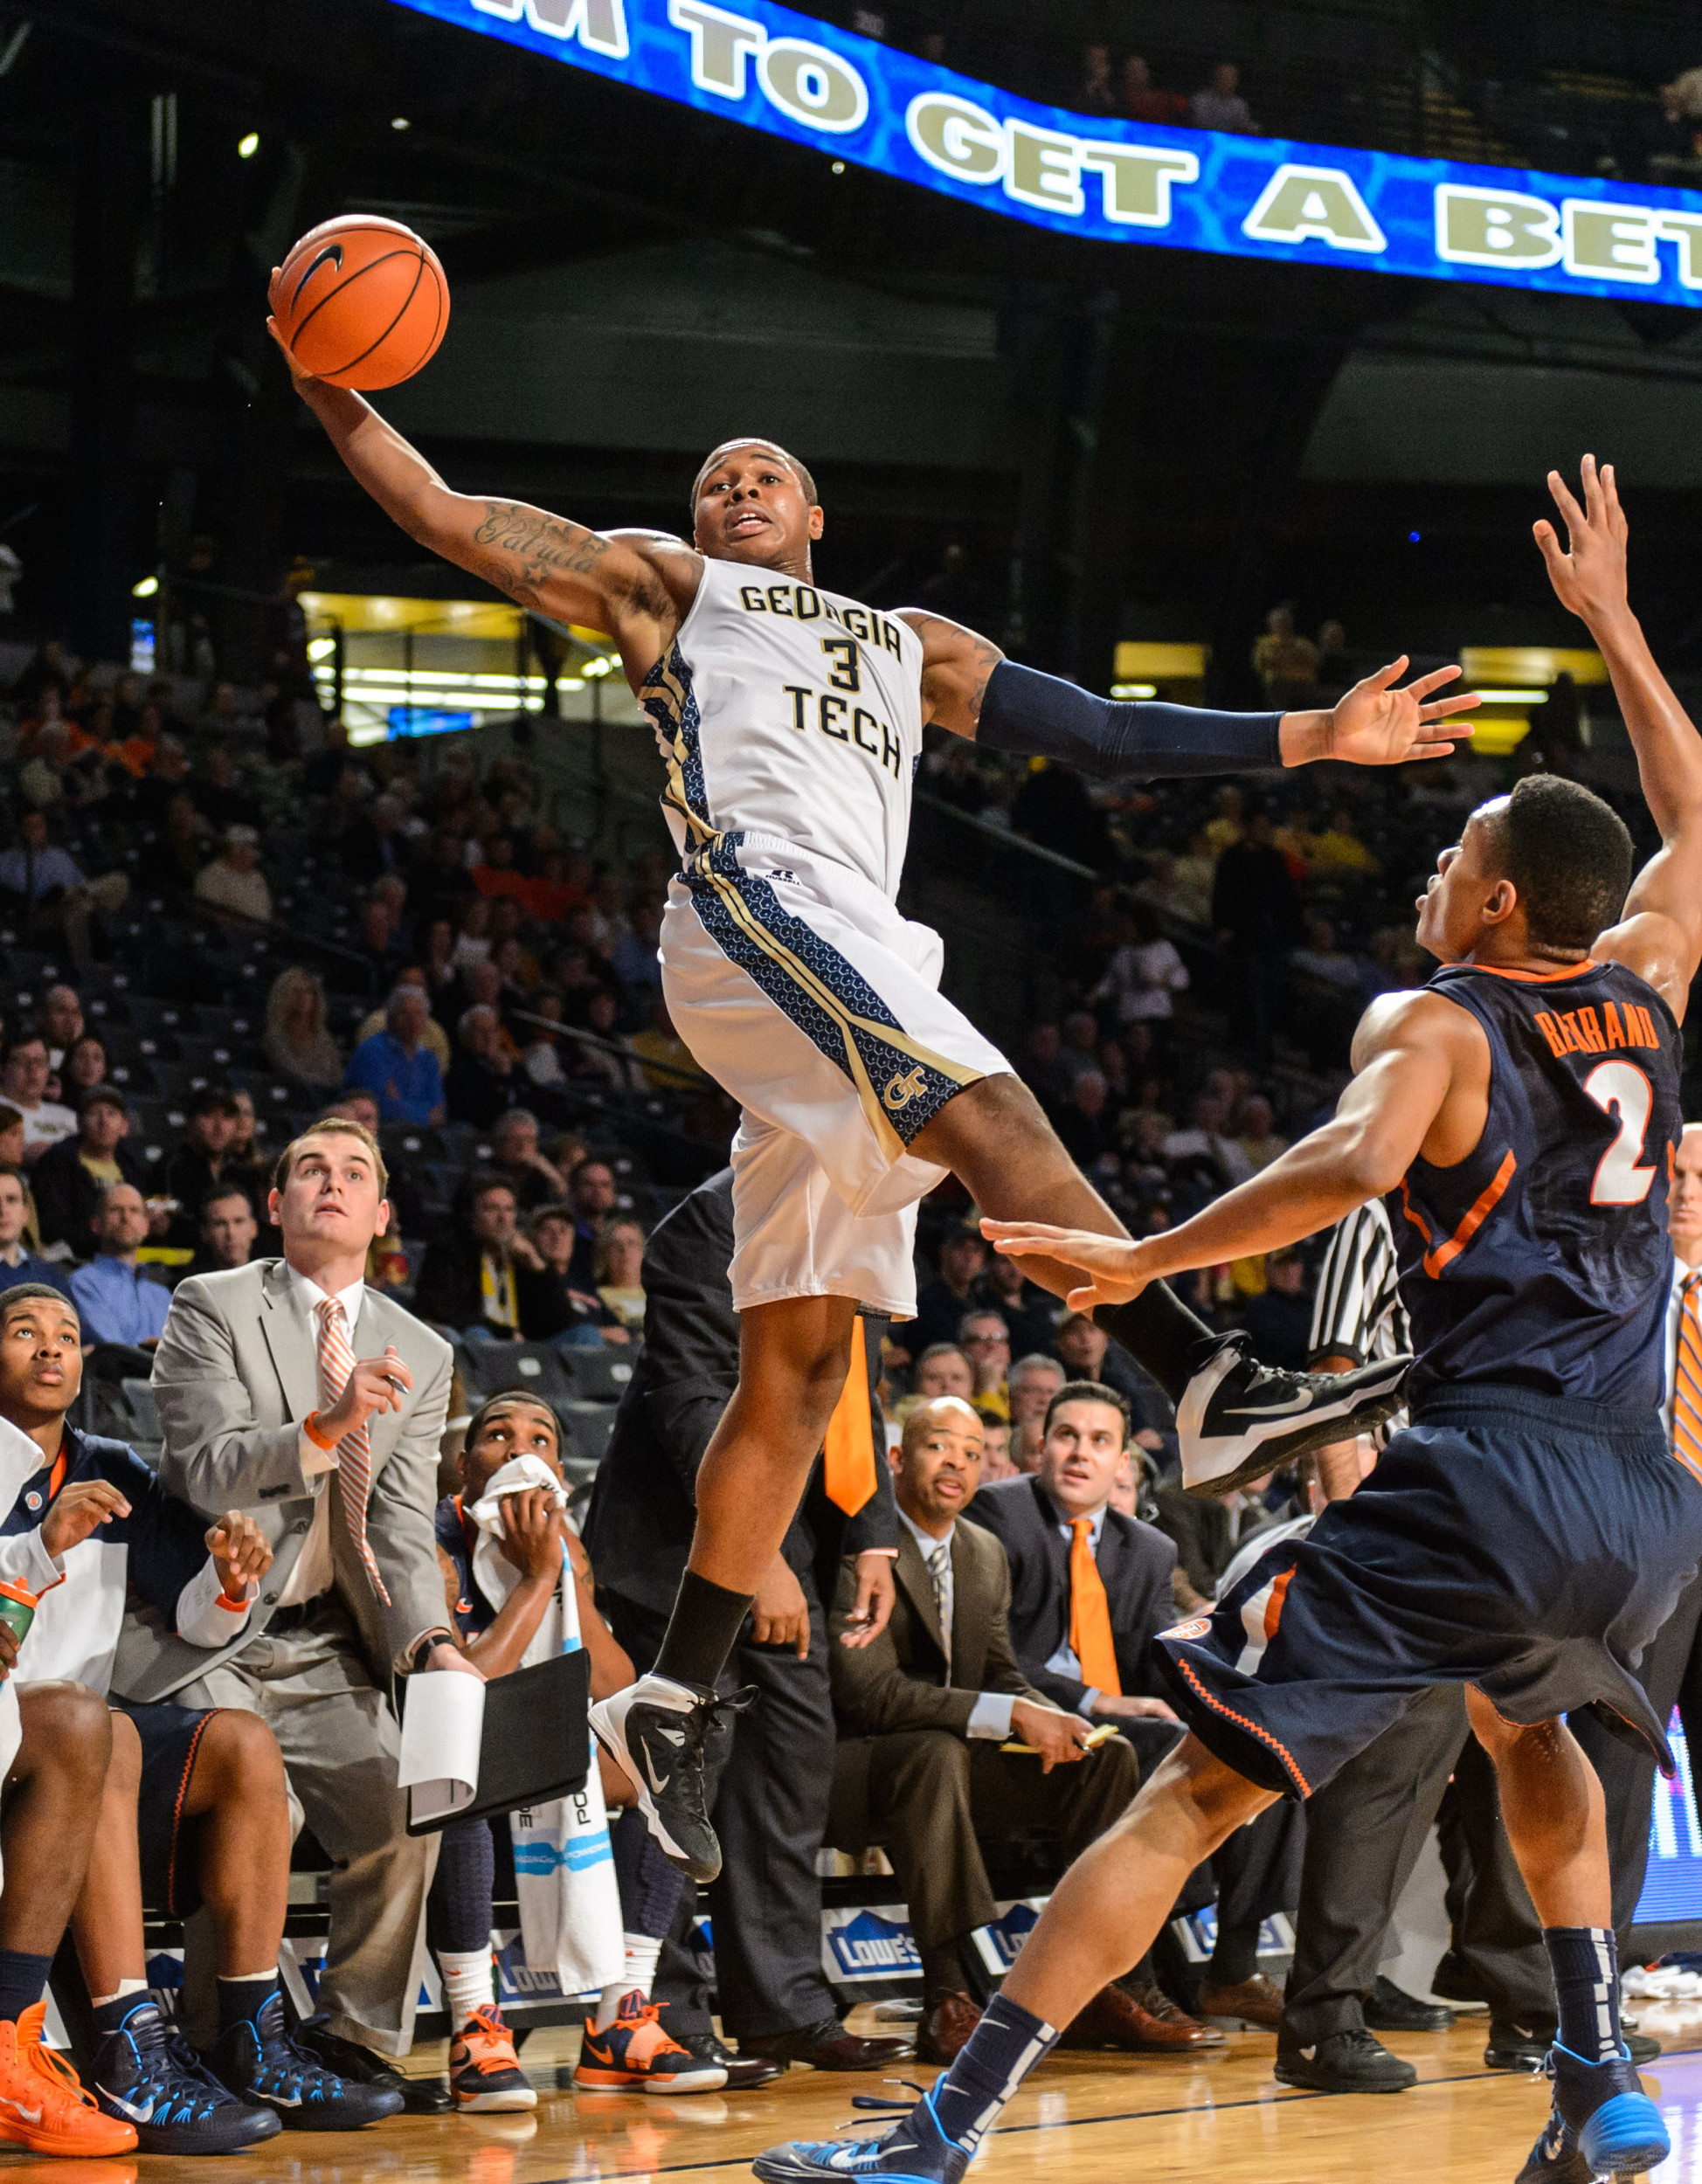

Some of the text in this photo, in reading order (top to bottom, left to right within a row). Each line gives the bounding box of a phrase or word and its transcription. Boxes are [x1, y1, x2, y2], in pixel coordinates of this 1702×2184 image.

[668, 0, 868, 134] TO
[905, 92, 1199, 226] GET
[1242, 163, 1387, 253] A
[738, 584, 903, 666] GEORGIA
[820, 637, 861, 695] 3
[783, 685, 902, 780] TECH
[1583, 1059, 1657, 1206] 2
